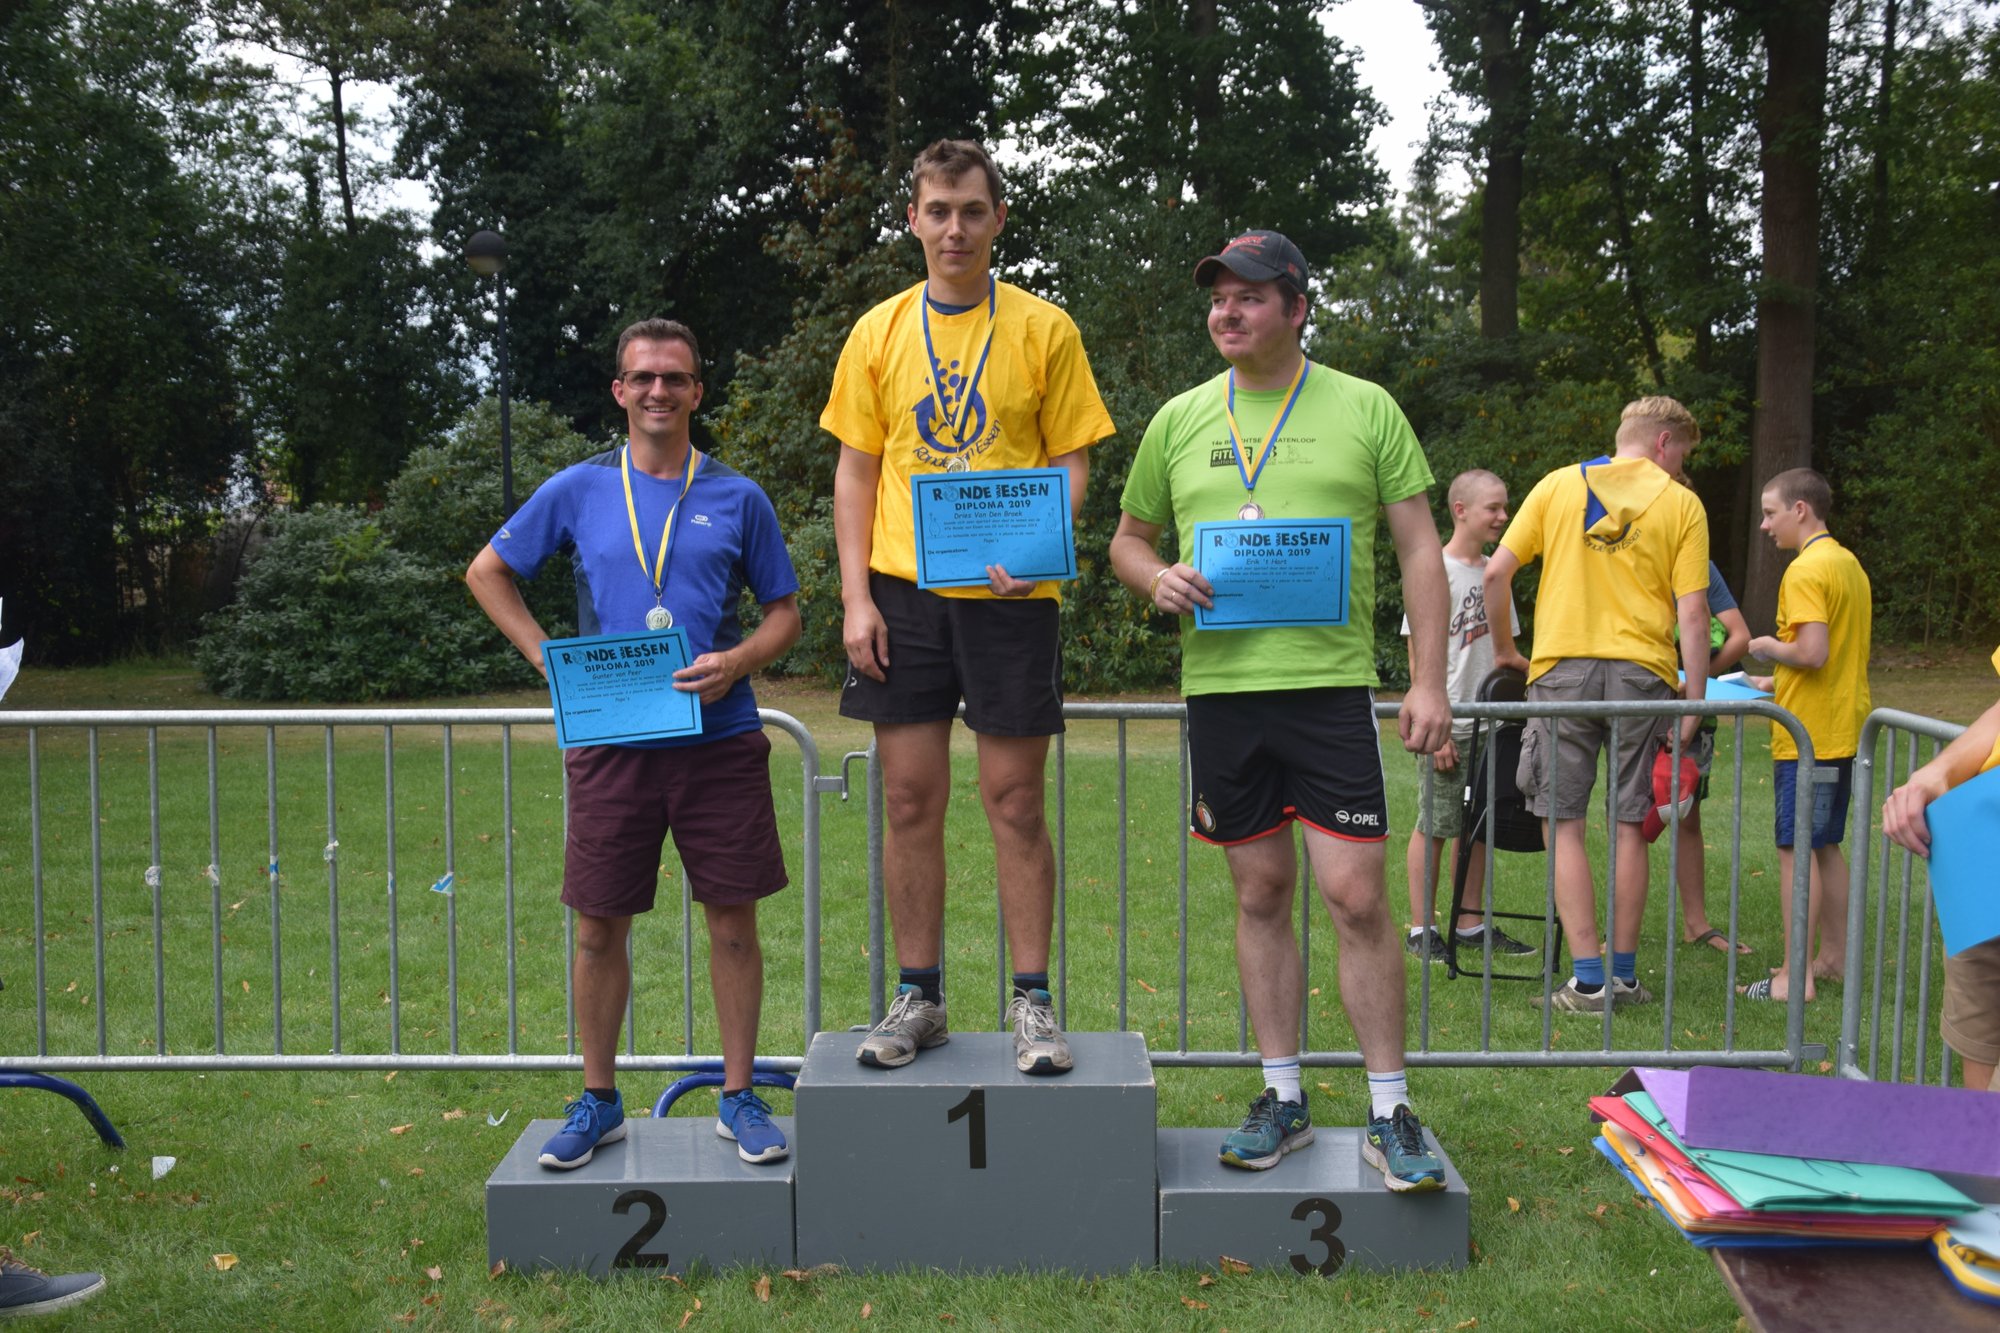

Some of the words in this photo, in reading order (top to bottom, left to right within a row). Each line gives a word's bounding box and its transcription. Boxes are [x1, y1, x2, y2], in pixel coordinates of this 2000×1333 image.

[1001, 482, 1049, 498] ESSEN
[955, 501, 1004, 511] DIPLOMA
[1008, 500, 1031, 509] 2019
[1281, 532, 1330, 547] ESSEN
[1234, 549, 1283, 557] DIPLOMA
[1287, 548, 1311, 557] 2019
[625, 642, 670, 658] ESSEN
[584, 662, 630, 673] DIPLOMA
[633, 658, 655, 668] 2019
[1352, 813, 1379, 826] OPEL
[947, 1089, 987, 1169] 1
[612, 1189, 669, 1270] 2
[1289, 1197, 1346, 1278] 3
